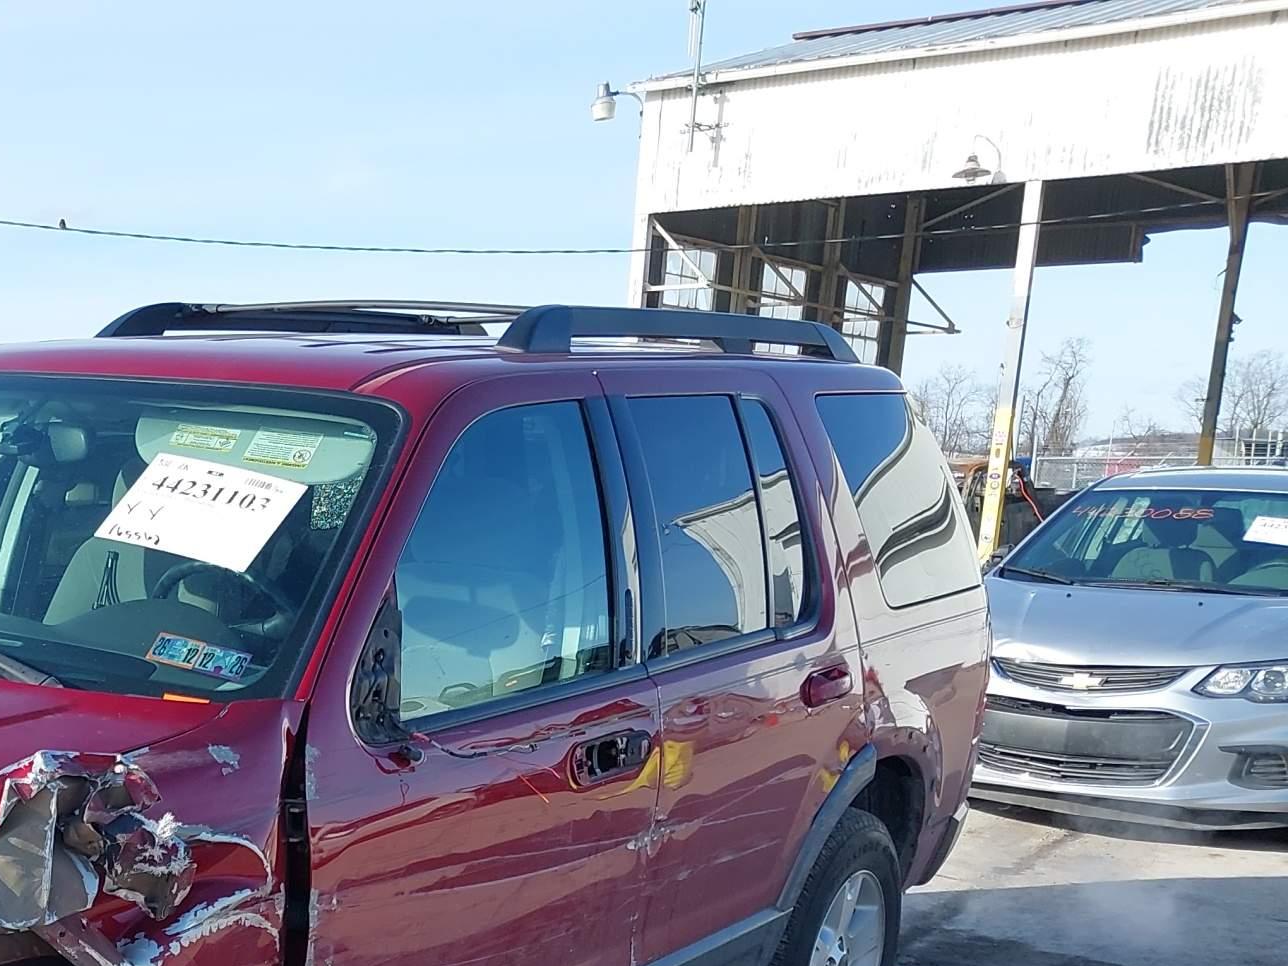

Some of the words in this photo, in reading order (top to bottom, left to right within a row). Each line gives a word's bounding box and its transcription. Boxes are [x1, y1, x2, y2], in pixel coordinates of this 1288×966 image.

[152, 476, 272, 511] 44231103
[182, 647, 200, 665] 12
[198, 652, 216, 669] 12
